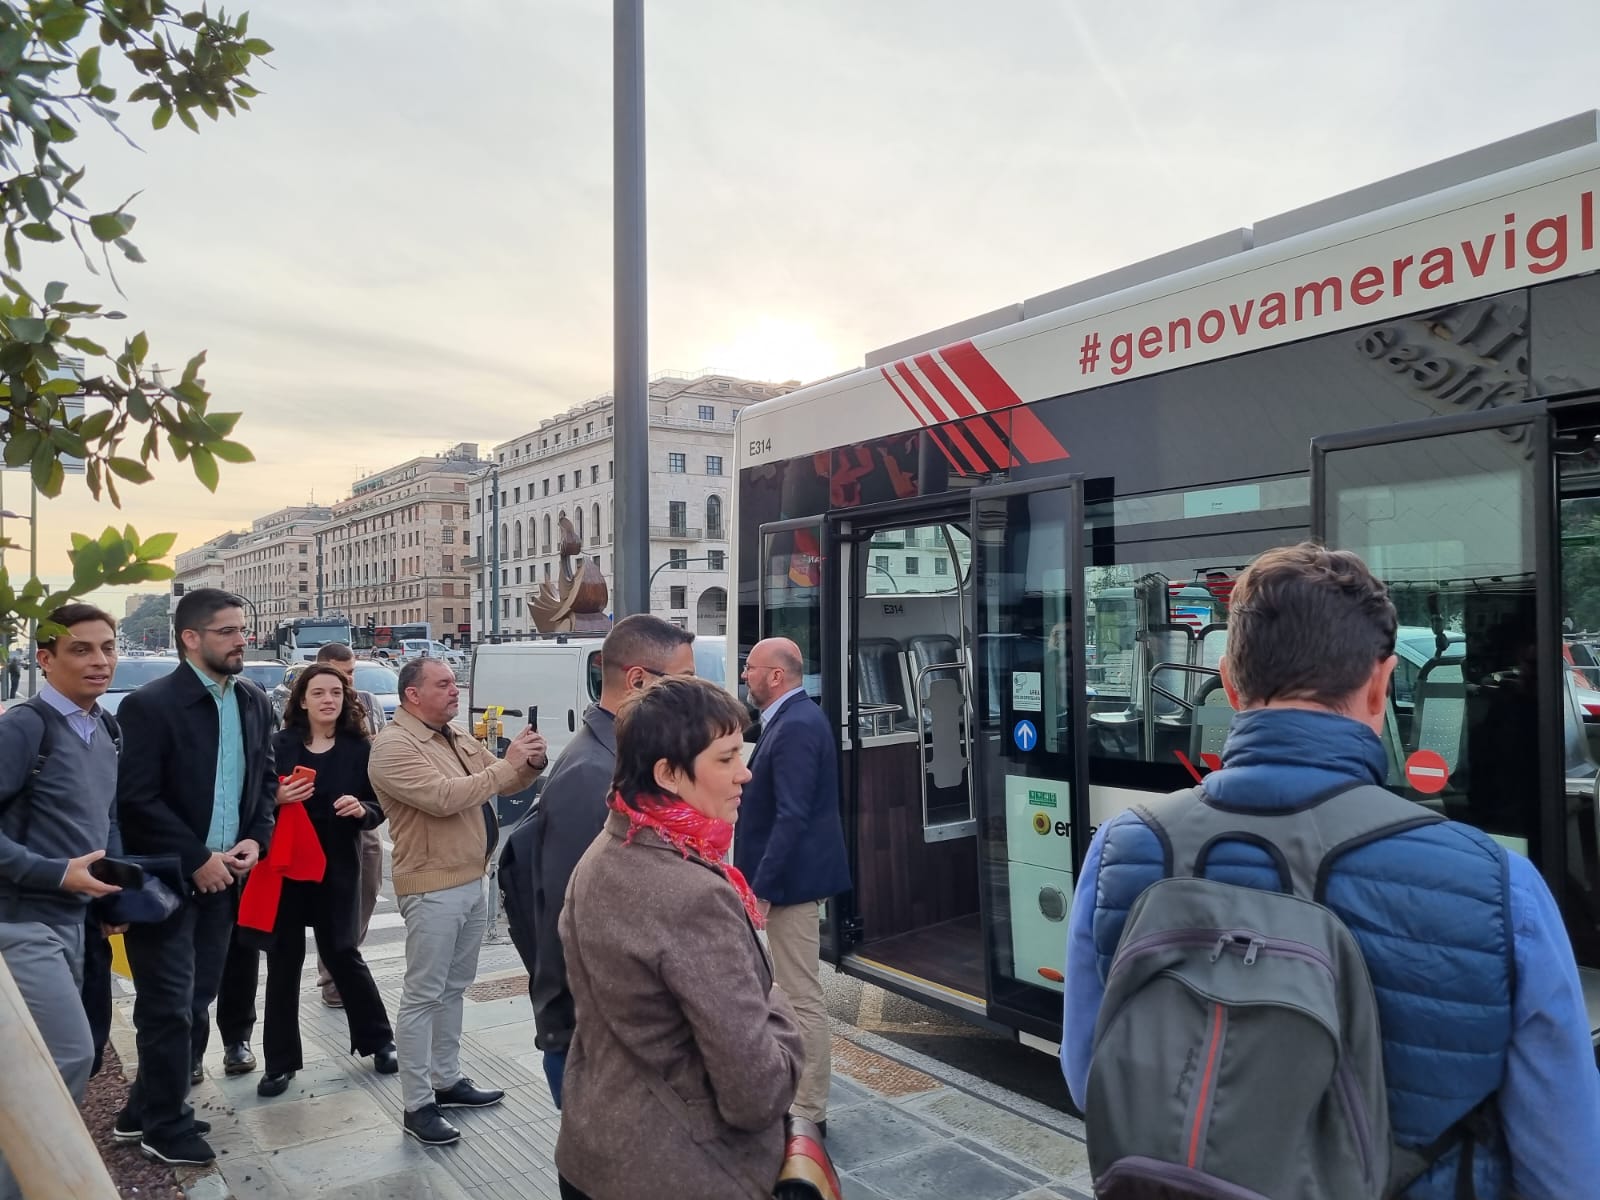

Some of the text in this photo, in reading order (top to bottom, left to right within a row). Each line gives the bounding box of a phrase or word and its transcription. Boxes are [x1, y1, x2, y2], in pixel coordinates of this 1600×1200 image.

[1079, 191, 1593, 376] #genovameravigl
[749, 437, 772, 457] E314
[883, 604, 904, 614] E314
